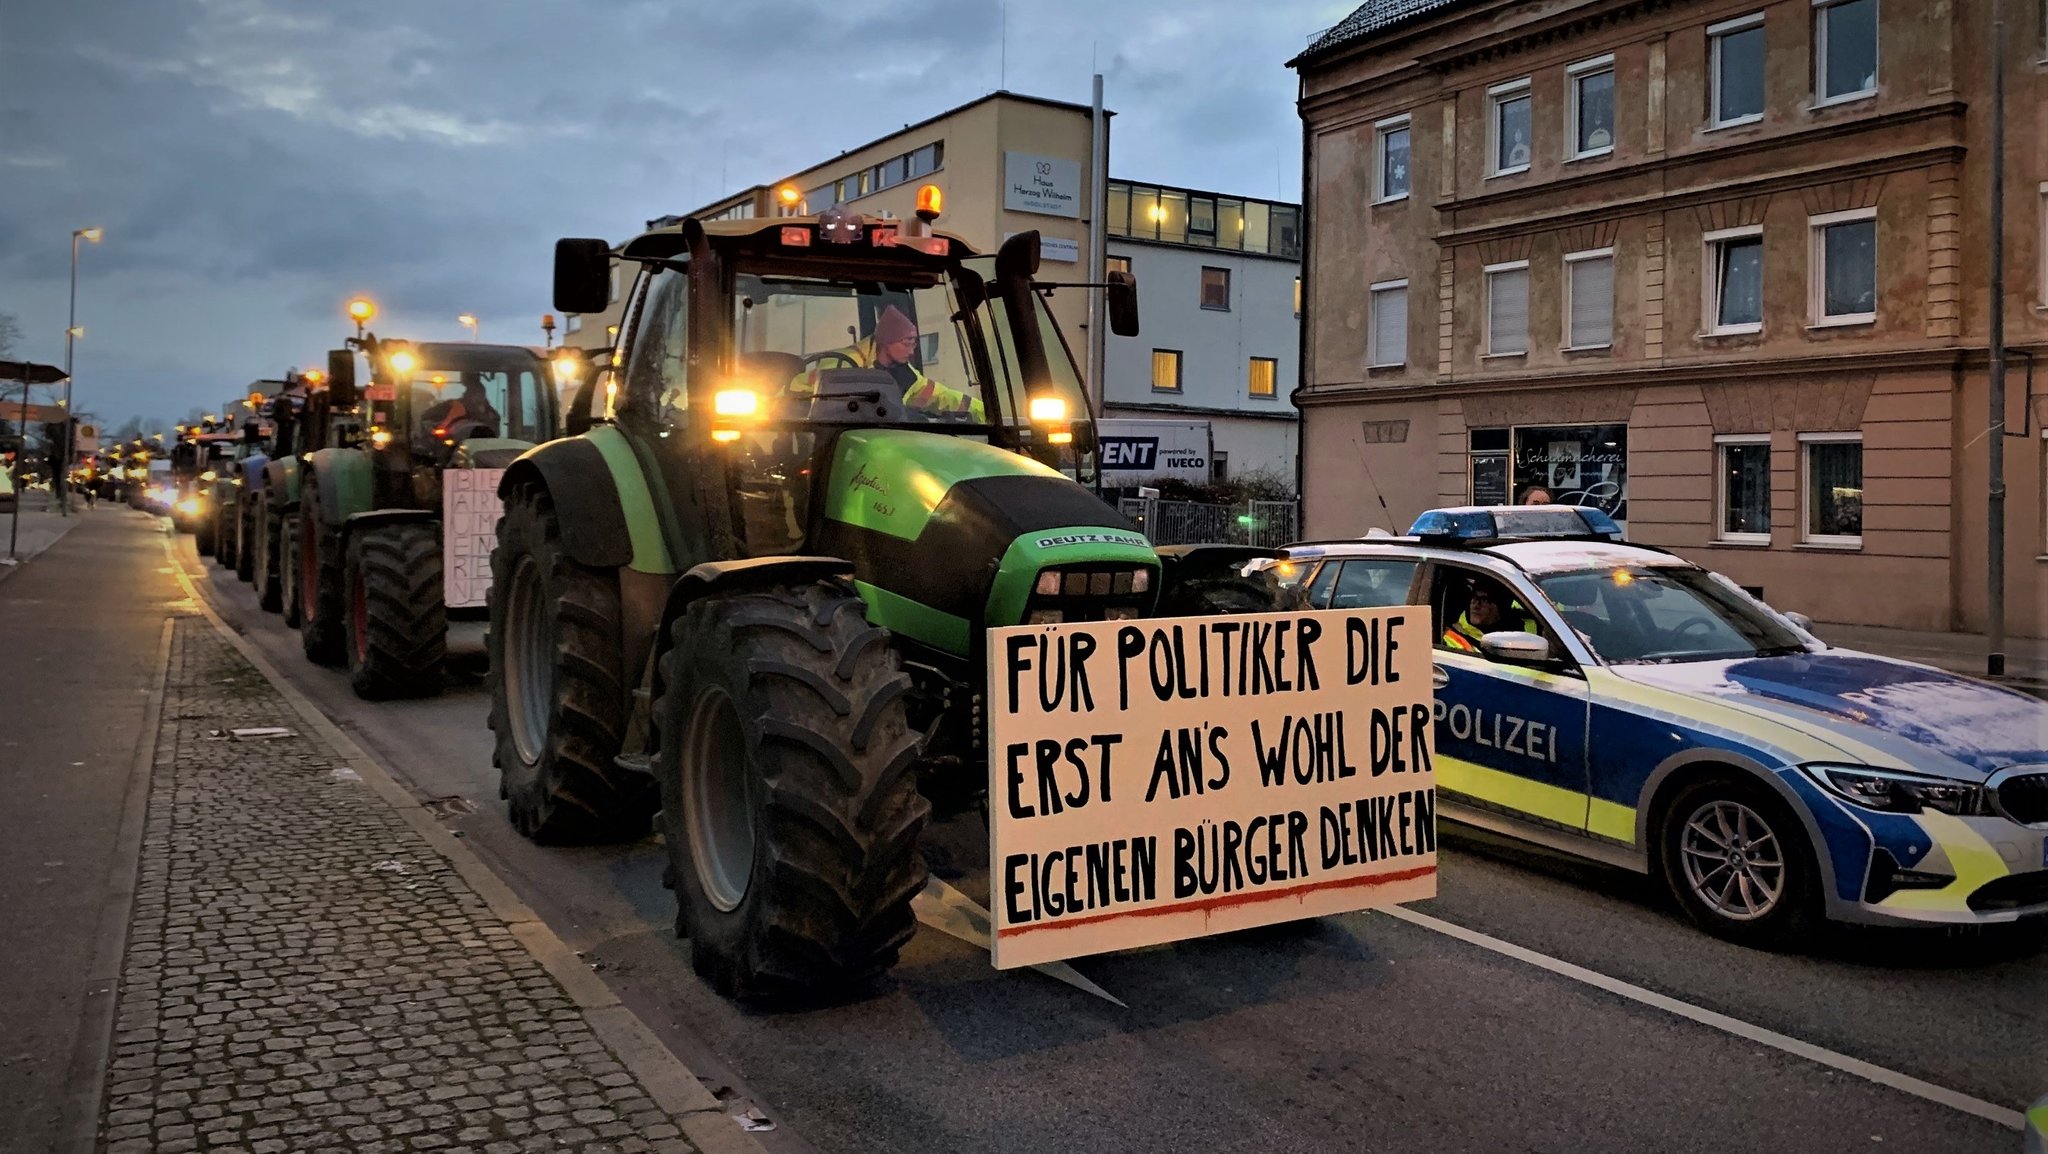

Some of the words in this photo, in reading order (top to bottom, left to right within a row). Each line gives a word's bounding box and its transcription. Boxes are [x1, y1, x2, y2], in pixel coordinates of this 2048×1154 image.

[1033, 175, 1054, 187] Haus
[1013, 183, 1041, 198] Herzog
[1042, 187, 1072, 201] Wilhelm
[1099, 442, 1154, 464] ENT
[1159, 448, 1187, 456] powered
[1188, 448, 1196, 457] by
[1167, 458, 1205, 468] IVECO
[1040, 534, 1100, 547] DEUTZ
[1103, 535, 1145, 546] FAHR
[1006, 627, 1097, 714] FÜR
[1117, 617, 1322, 711] POLITIKER
[1346, 616, 1405, 686] DIE
[1433, 698, 1557, 763] POLIZEI
[1006, 734, 1123, 819] ERST
[1145, 721, 1230, 802] AN'S
[1250, 710, 1356, 788] WOHL
[1370, 703, 1433, 777] DER
[1004, 836, 1157, 924] EIGENEN
[1174, 810, 1309, 899] BÜRGER
[1320, 788, 1436, 870] DENKEN
